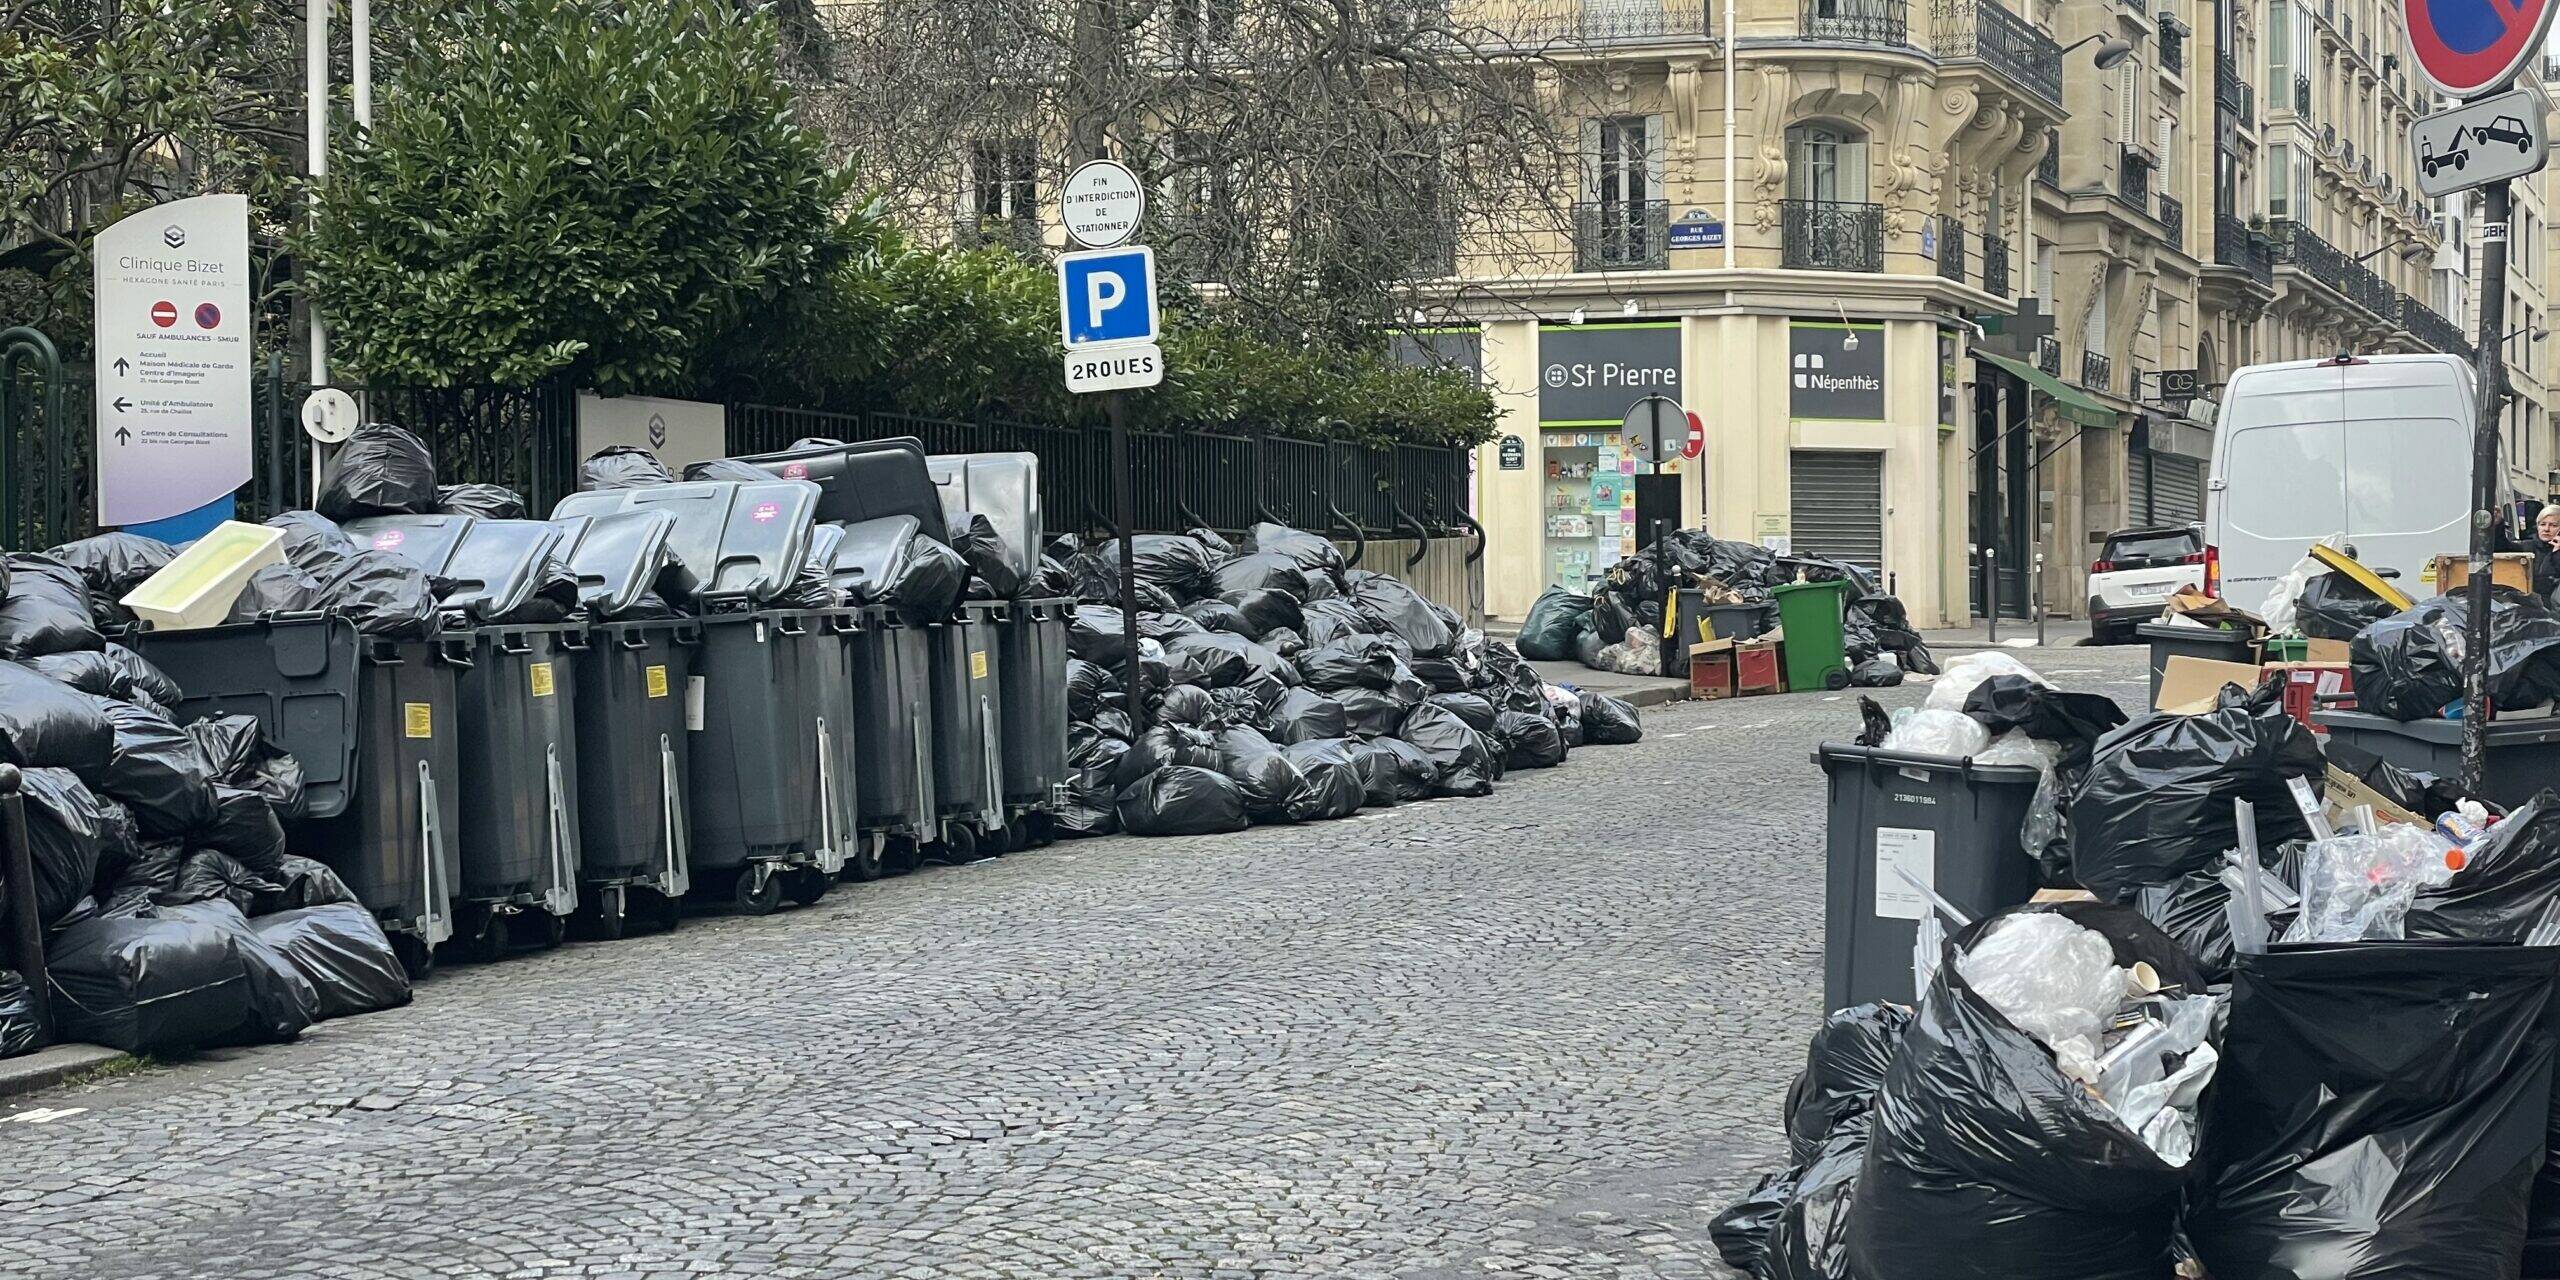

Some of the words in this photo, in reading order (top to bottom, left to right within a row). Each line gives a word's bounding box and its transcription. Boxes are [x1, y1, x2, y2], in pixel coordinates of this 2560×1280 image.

[1093, 177, 1108, 187] FIN
[1066, 190, 1136, 204] D'INTERDICTION
[1095, 207, 1107, 217] DE
[1075, 221, 1129, 234] STATIONNER
[1690, 226, 1704, 234] RUE
[1671, 234, 1701, 243] GEORGES
[1702, 233, 1722, 241] BIZET
[119, 256, 182, 273] Clinique
[187, 259, 224, 274] Bizet
[122, 276, 169, 285] HEXAGONE
[201, 279, 225, 288] PARIS
[1087, 270, 1126, 328] P
[136, 332, 157, 340] SAUF
[159, 333, 212, 342] AMBULANCES
[217, 335, 240, 343] SMUR
[167, 360, 200, 369] Médicale
[212, 362, 234, 370] Garde
[1072, 356, 1154, 381] 2ROUES
[1571, 363, 1596, 387] St
[1603, 362, 1676, 386] Pierre
[1811, 374, 1879, 393] Népenthès
[140, 399, 160, 407] Unité
[162, 399, 214, 408] d'Ambulatoire
[178, 430, 229, 438] Consultations
